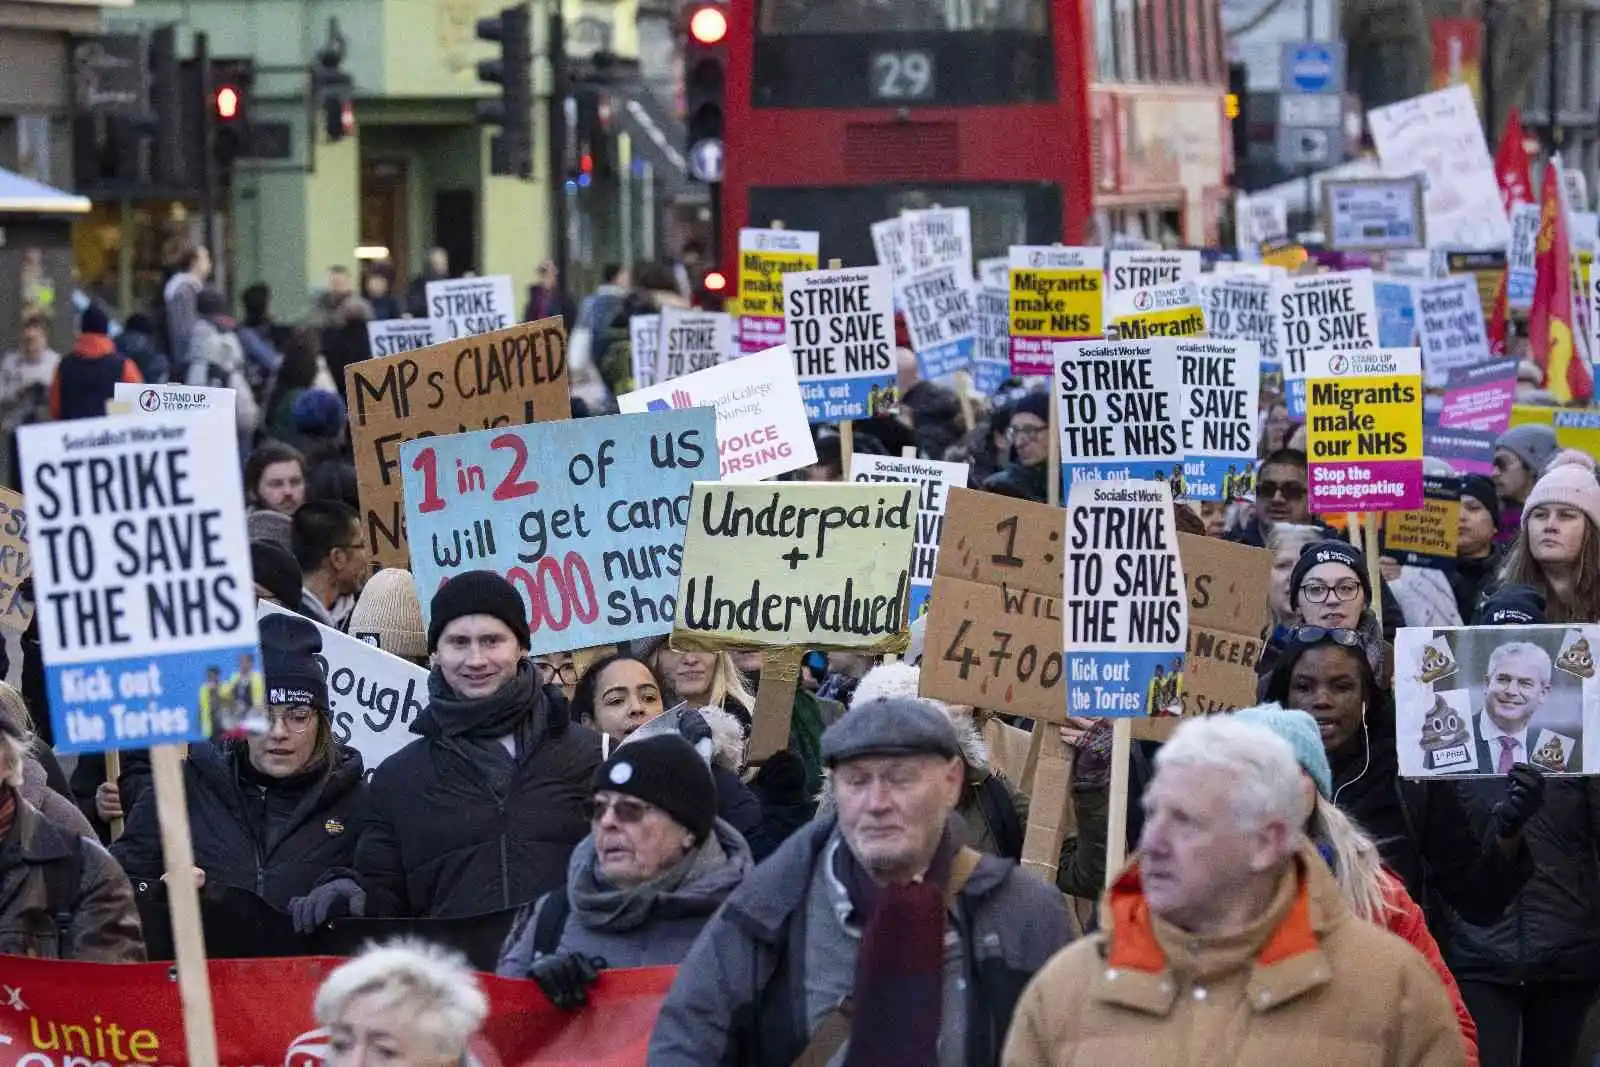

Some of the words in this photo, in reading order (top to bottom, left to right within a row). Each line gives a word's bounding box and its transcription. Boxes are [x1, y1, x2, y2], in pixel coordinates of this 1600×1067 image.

[877, 53, 931, 98] 29
[904, 272, 958, 300] STRIKE
[1014, 272, 1098, 295] Migrants
[434, 291, 496, 317] STRIKE
[790, 285, 871, 317] STRIKE
[908, 304, 931, 324] TO
[936, 289, 971, 317] SAVE
[1014, 294, 1065, 312] make
[1210, 287, 1269, 312] STRIKE
[1280, 287, 1355, 320] STRIKE
[791, 319, 820, 347] TO
[830, 313, 885, 344] SAVE
[915, 323, 942, 345] THE
[1014, 317, 1046, 331] our
[1051, 313, 1090, 332] NHS
[1119, 313, 1204, 341] Migrants
[1210, 311, 1229, 331] TO
[1237, 313, 1277, 335] SAVE
[1283, 320, 1311, 346] TO
[1318, 313, 1369, 343] SAVE
[668, 328, 716, 351] STRIKE
[1079, 347, 1117, 357] Socialist
[1118, 347, 1151, 356] Worker
[1207, 345, 1236, 354] Worker
[454, 327, 566, 400] CLAPPED
[667, 352, 685, 376] TO
[793, 347, 837, 376] THE
[845, 343, 890, 373] NHS
[1177, 355, 1236, 387] RIKE
[1351, 354, 1378, 363] STAND
[1380, 353, 1392, 363] UP
[1352, 364, 1363, 373] TO
[1364, 363, 1397, 373] RACISM
[1061, 358, 1154, 391] STRIKE
[163, 392, 191, 402] STAND
[193, 393, 206, 403] UP
[829, 383, 850, 398] out
[1190, 388, 1248, 419] SAVE
[1312, 382, 1415, 410] Migrants
[805, 404, 820, 418] he
[1062, 393, 1096, 424] TO
[1107, 392, 1170, 423] SAVE
[1313, 409, 1375, 432] make
[1065, 426, 1115, 457] THE
[1124, 424, 1177, 456] NHS
[1203, 422, 1251, 452] NHS
[1313, 439, 1352, 457] our
[1357, 432, 1408, 455] NHS
[412, 447, 446, 513] 1
[455, 458, 486, 495] in
[490, 433, 540, 501] 2
[568, 439, 615, 489] of
[650, 430, 704, 470] us
[874, 461, 911, 474] Socialist
[911, 464, 943, 477] Worker
[1184, 460, 1206, 476] out
[1314, 467, 1345, 485] Stop
[1348, 465, 1371, 480] the
[35, 449, 194, 521] STRIKE
[1094, 488, 1138, 502] Socialist
[1314, 480, 1404, 499] scapegoating
[518, 503, 592, 564] get
[702, 489, 912, 559] Underpaid
[1071, 505, 1167, 550] STRIKE
[39, 523, 95, 583] TO
[113, 508, 227, 578] SAVE
[782, 546, 809, 570] +
[1070, 553, 1103, 597] TO
[1114, 553, 1178, 597] SAVE
[48, 586, 131, 649] THE
[146, 575, 241, 640] NHS
[684, 569, 907, 636] Undervalued
[1069, 600, 1119, 643] THE
[1128, 600, 1181, 644] NHS
[1072, 656, 1099, 681] Kick
[1103, 657, 1131, 681] out
[61, 664, 114, 704] Kick
[119, 662, 163, 699] out
[1072, 686, 1091, 711] the
[1094, 686, 1141, 711] Tories
[66, 708, 105, 743] the
[109, 701, 189, 742] Tories
[30, 1015, 160, 1062] unite
